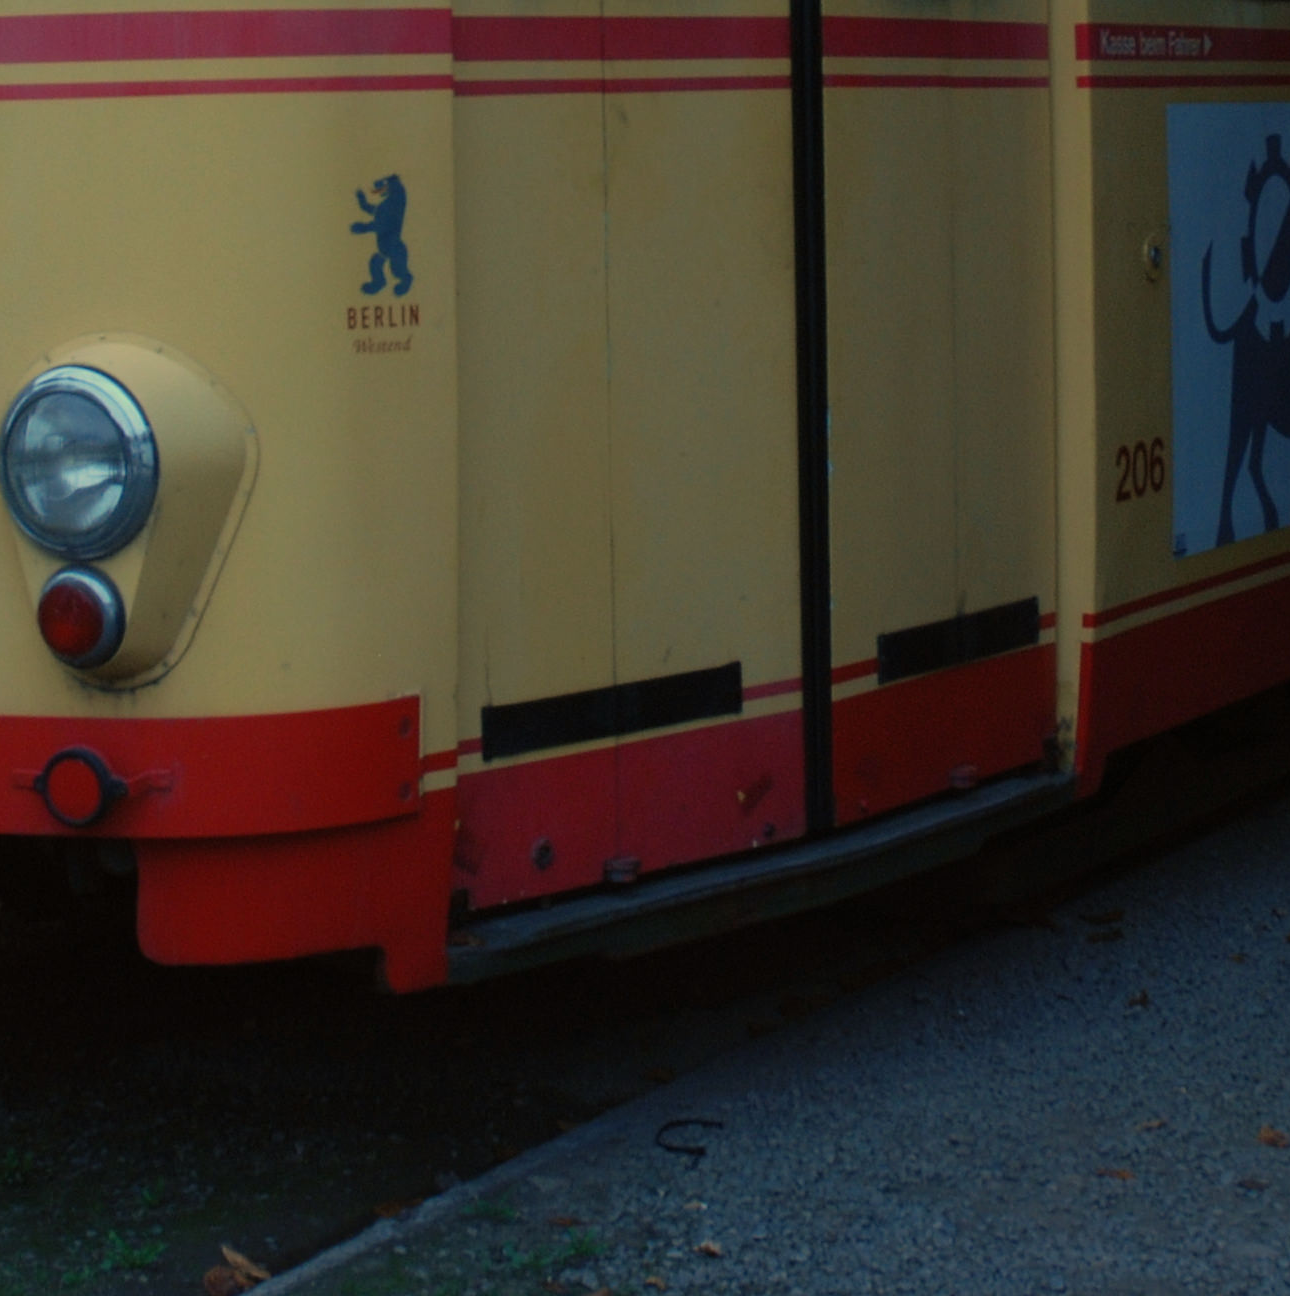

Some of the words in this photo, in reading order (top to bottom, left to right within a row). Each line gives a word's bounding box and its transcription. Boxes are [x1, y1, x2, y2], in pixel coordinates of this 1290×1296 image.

[1099, 26, 1136, 55] Kasse
[1139, 28, 1165, 57] beim
[347, 305, 420, 329] BERLIN
[1115, 437, 1165, 502] 206
